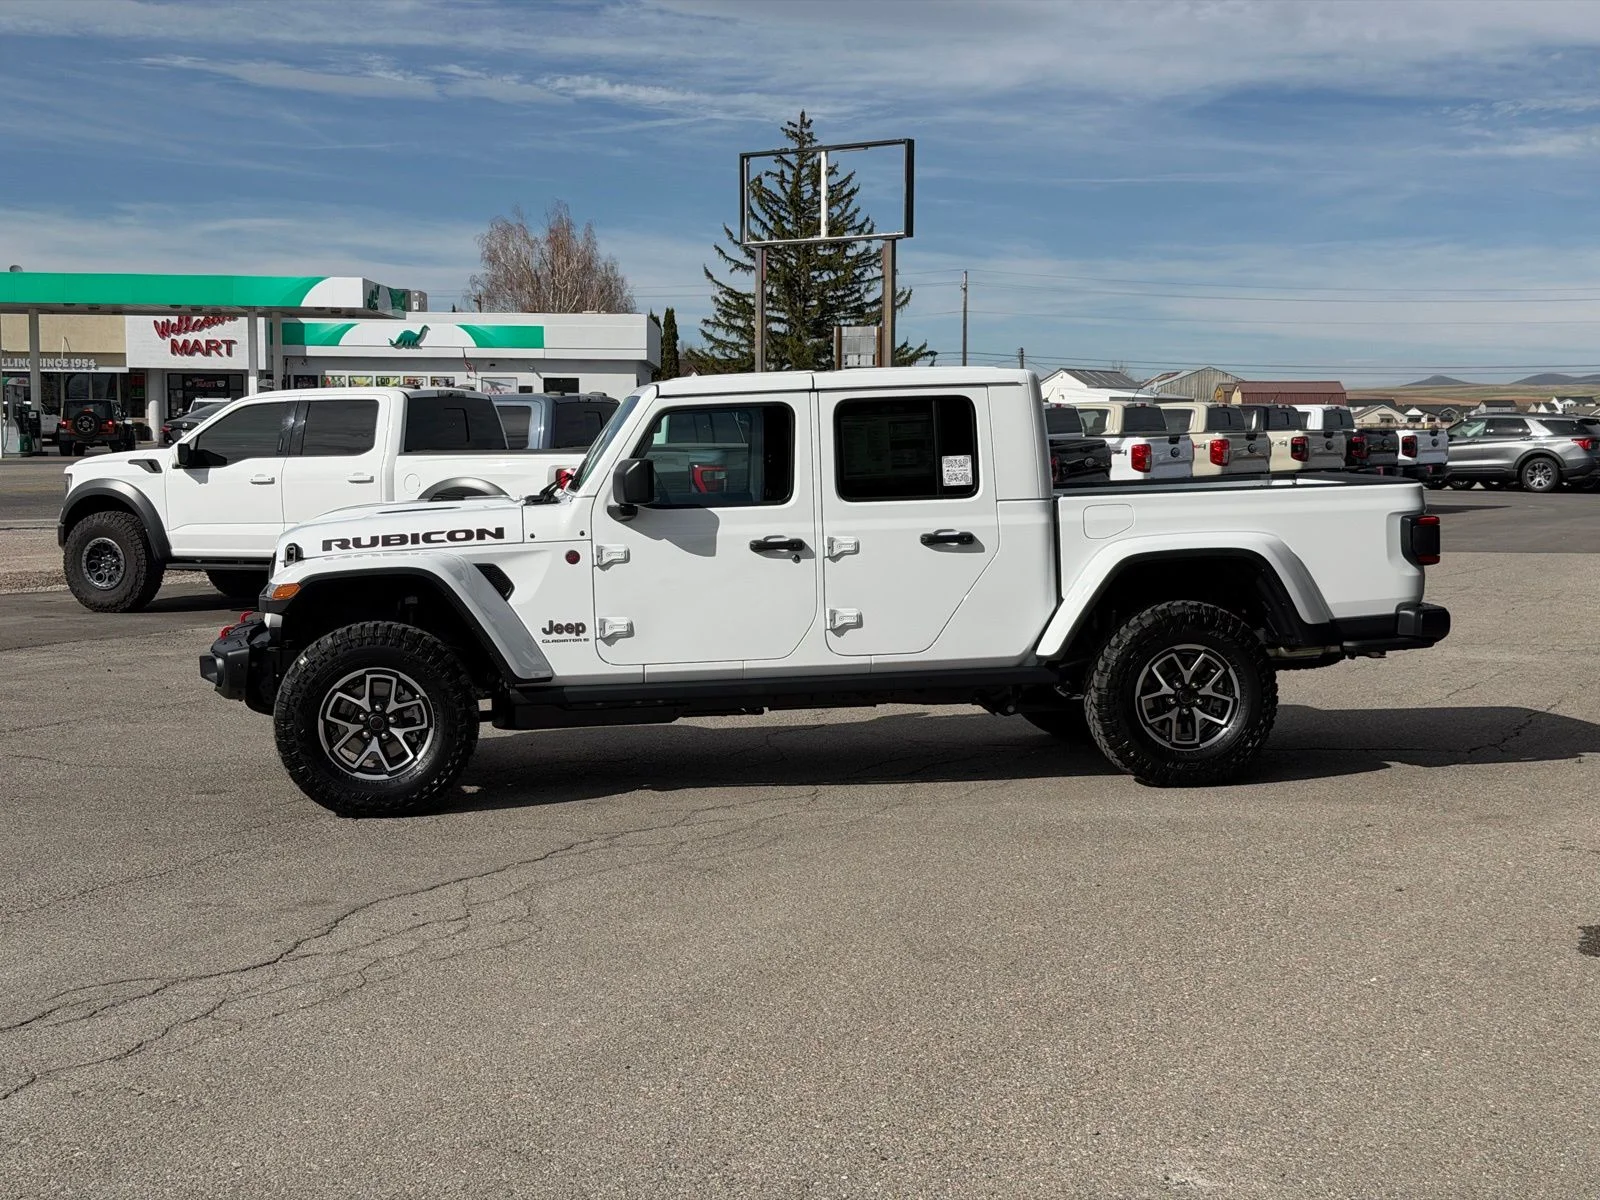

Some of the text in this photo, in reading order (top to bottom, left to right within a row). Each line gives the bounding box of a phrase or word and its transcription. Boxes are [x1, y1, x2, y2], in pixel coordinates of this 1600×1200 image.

[170, 338, 238, 357] MART
[70, 358, 97, 368] 1954
[322, 526, 505, 552] RUBICON
[541, 619, 587, 637] Jeep
